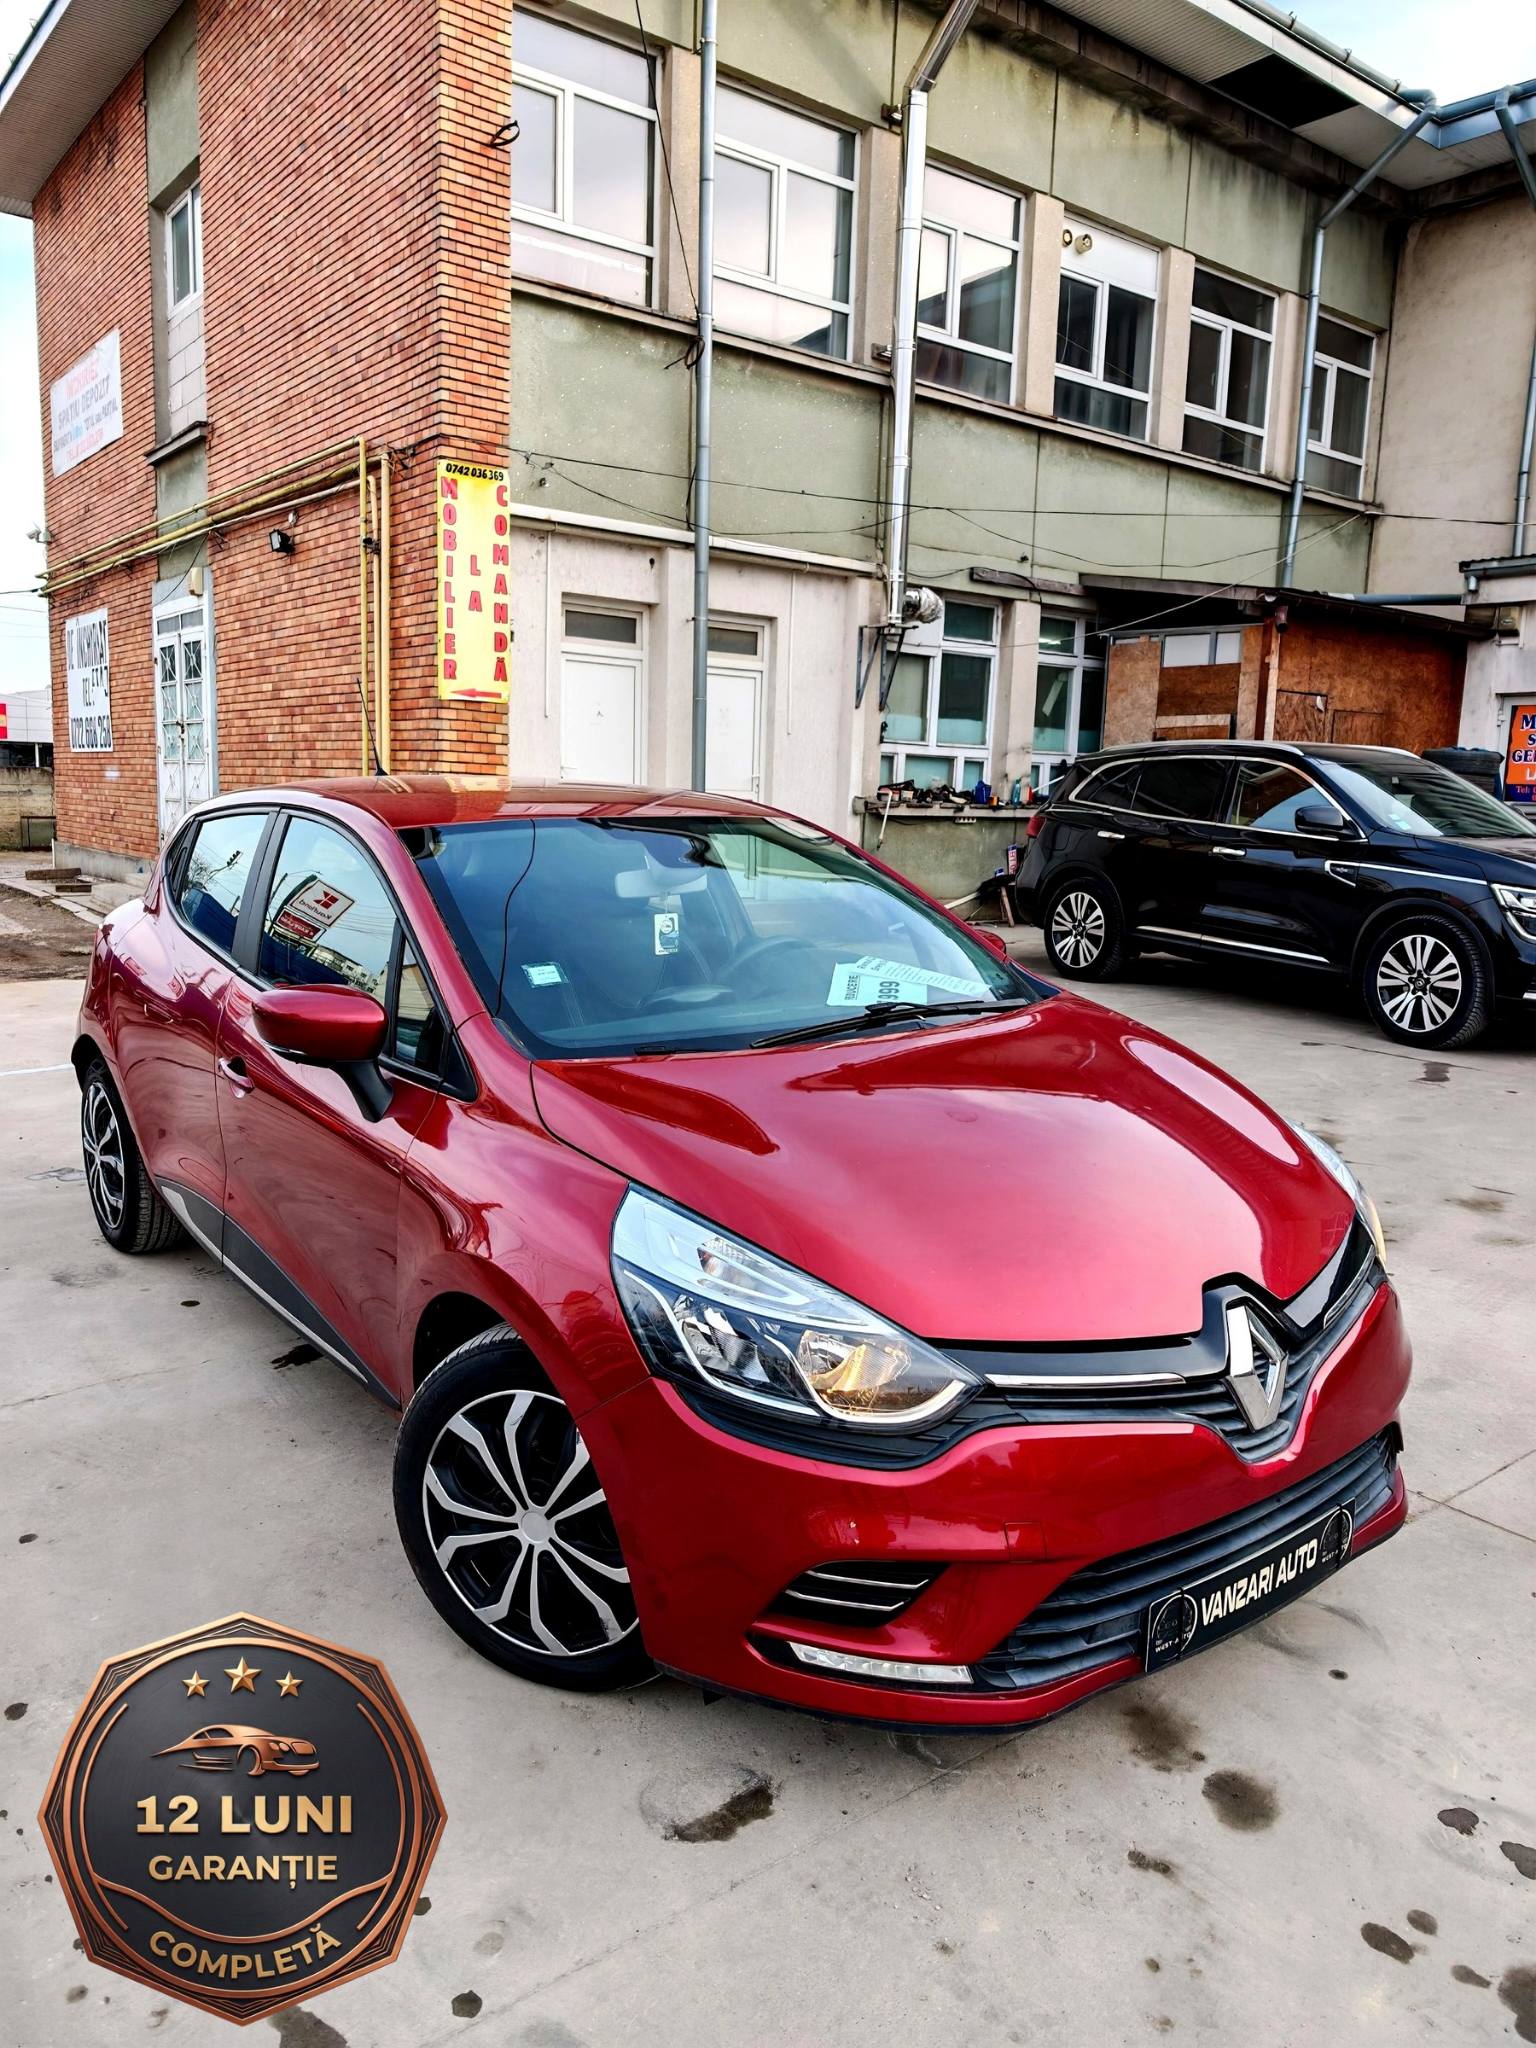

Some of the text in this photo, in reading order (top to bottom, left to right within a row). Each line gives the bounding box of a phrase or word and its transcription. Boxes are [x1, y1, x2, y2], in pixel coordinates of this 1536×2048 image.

[446, 463, 504, 481] 0742 036 369
[877, 980, 900, 1003] 999
[1201, 1538, 1318, 1626] VANZARI AUTO
